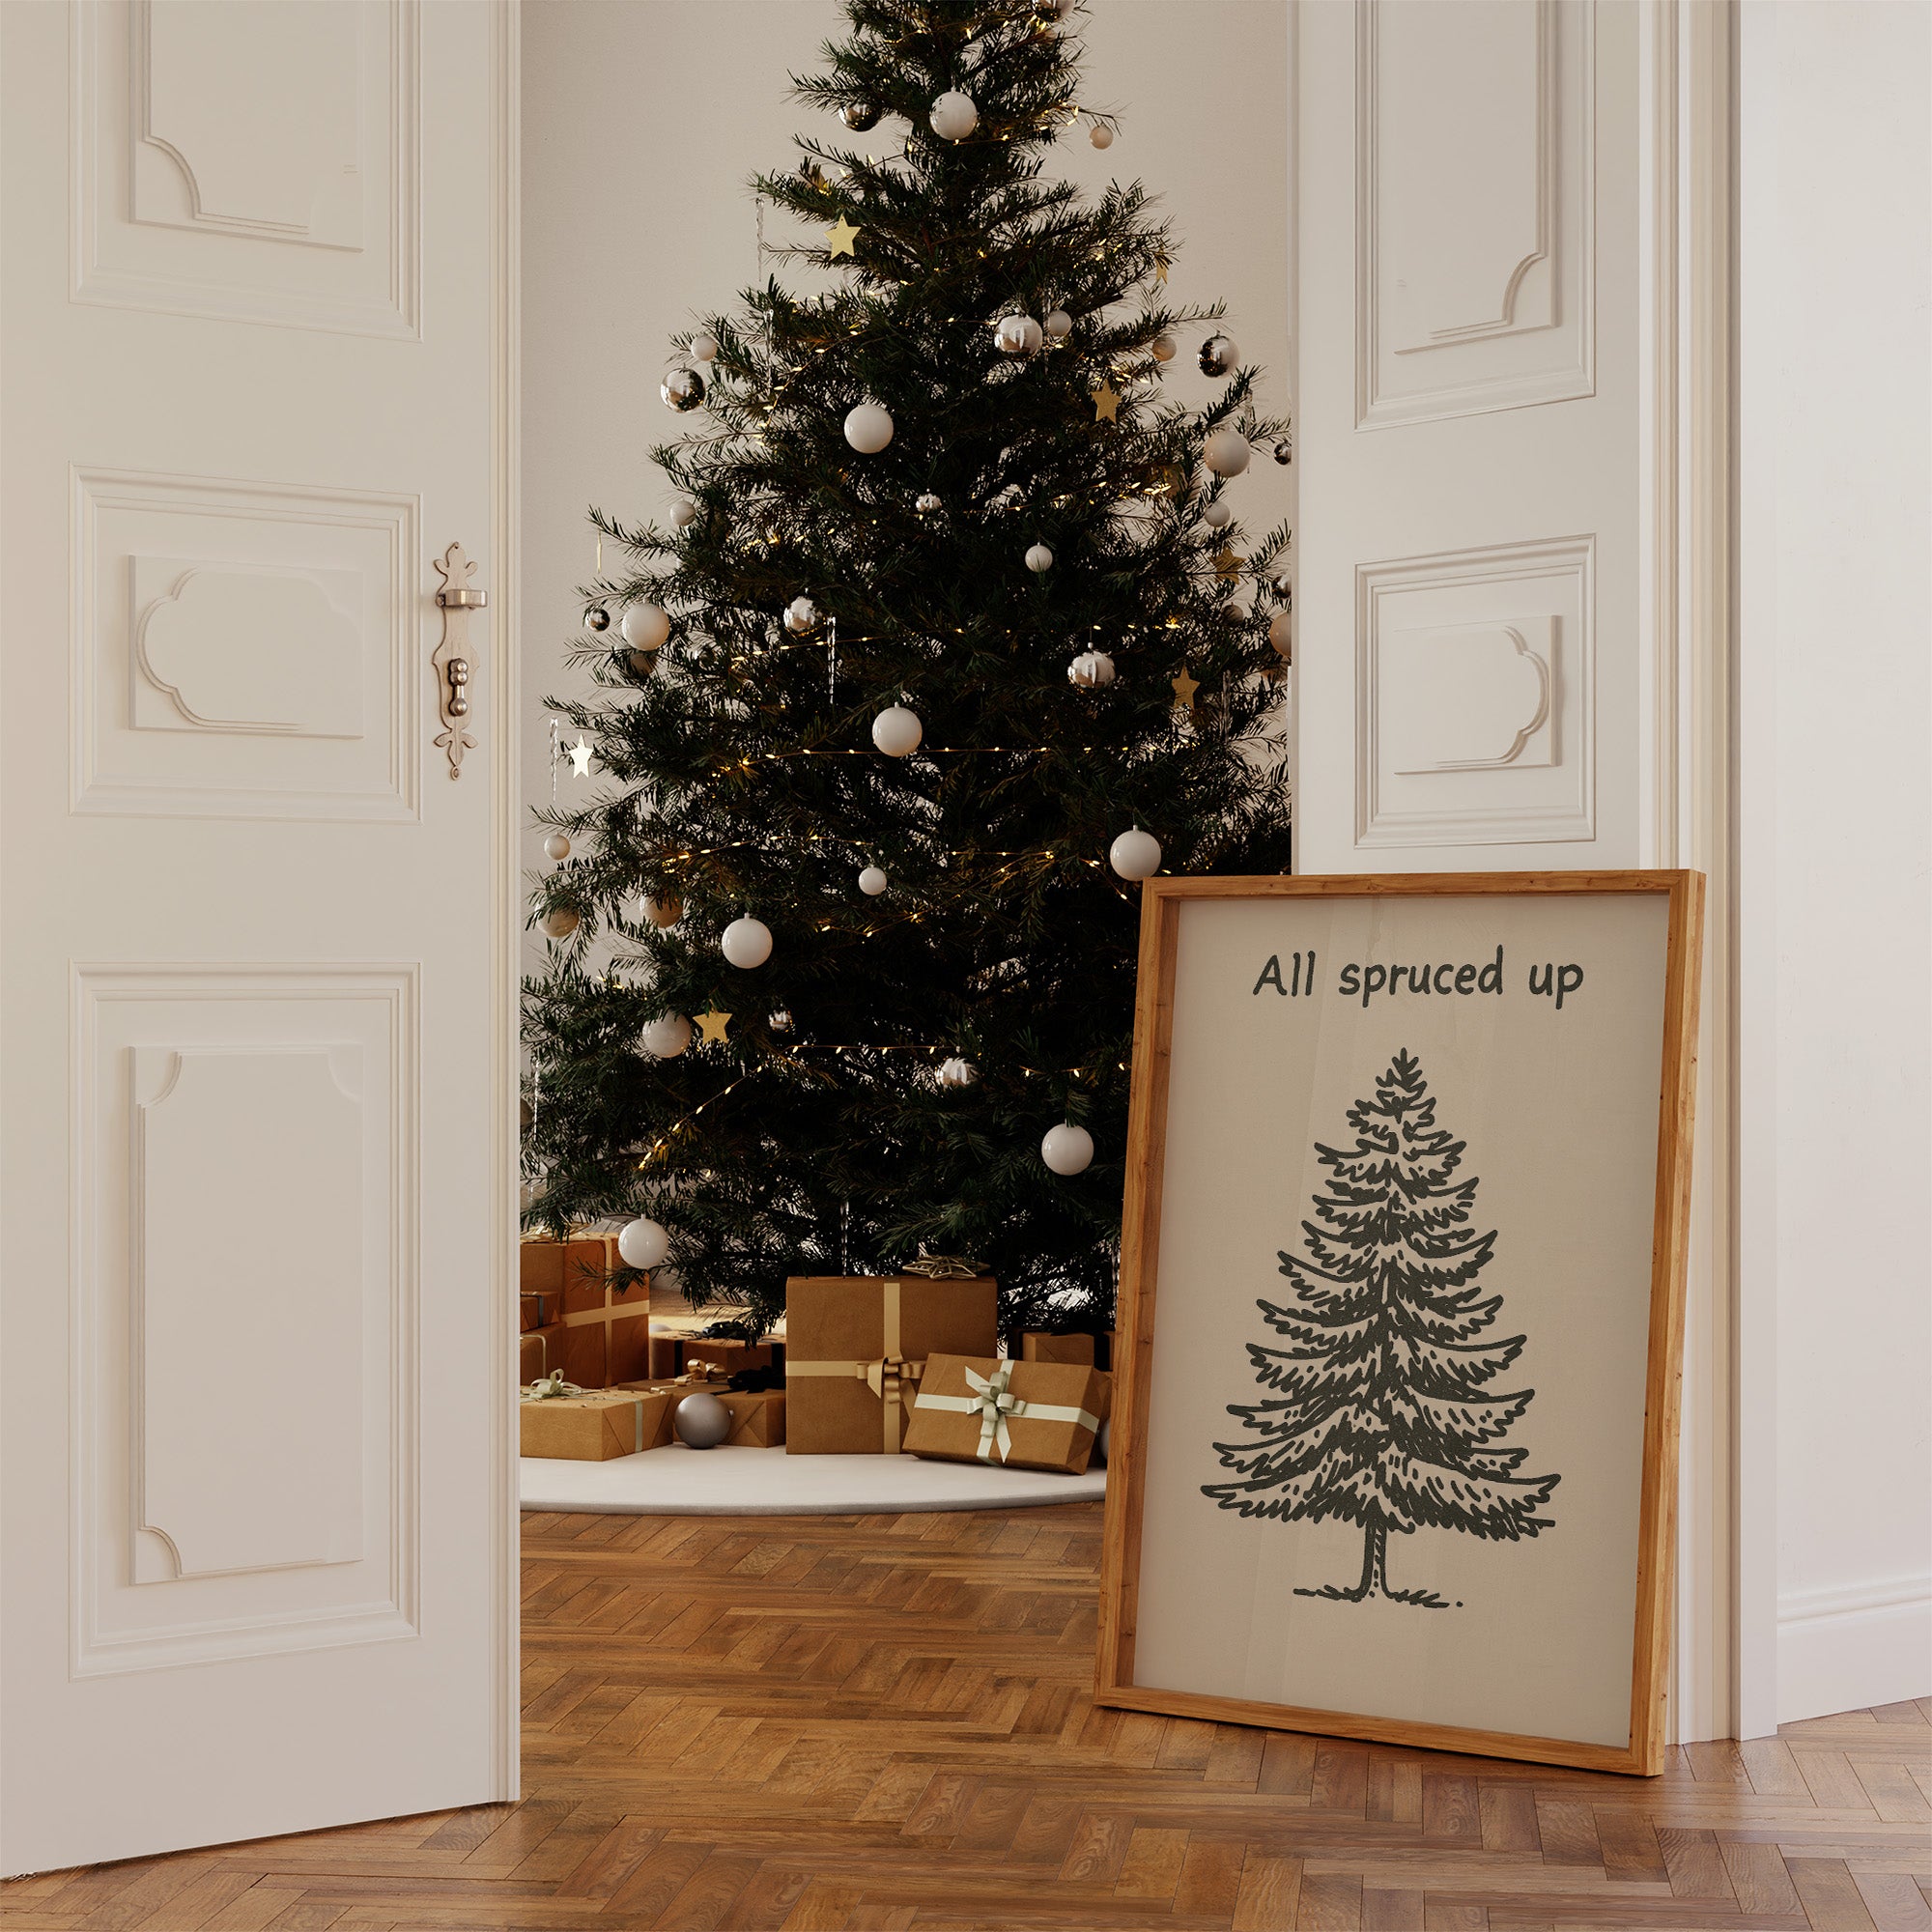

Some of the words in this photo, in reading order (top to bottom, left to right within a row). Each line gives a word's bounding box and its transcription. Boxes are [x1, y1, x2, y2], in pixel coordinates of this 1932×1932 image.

[1253, 951, 1316, 997] All
[1339, 945, 1504, 1009] spruced
[1529, 963, 1583, 1009] up
